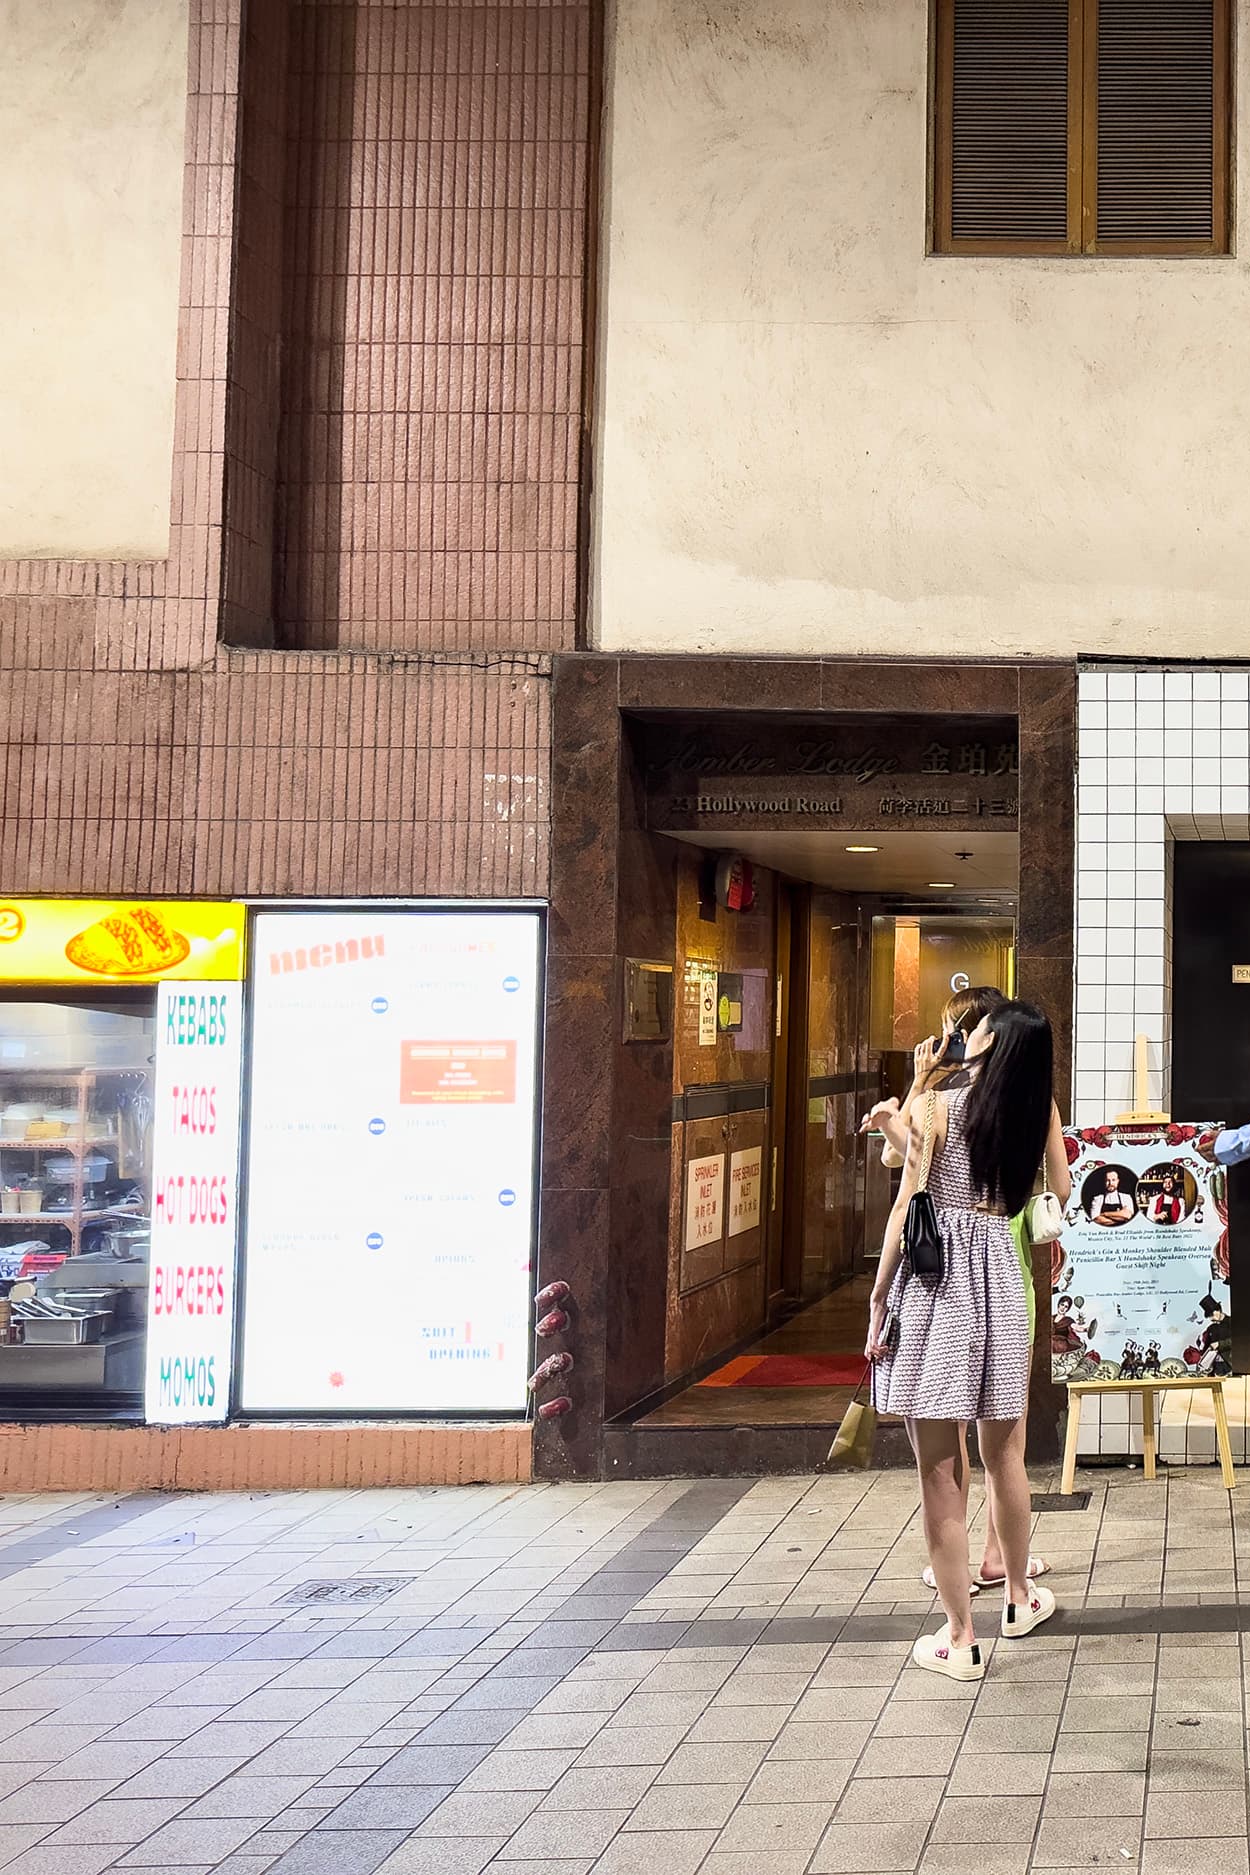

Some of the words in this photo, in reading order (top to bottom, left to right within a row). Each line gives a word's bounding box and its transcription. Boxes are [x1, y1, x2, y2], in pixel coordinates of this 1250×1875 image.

[788, 740, 899, 783] Lodge
[697, 796, 792, 815] Hollywood
[796, 797, 842, 813] Road
[269, 934, 384, 976] menu
[951, 972, 969, 993] G
[167, 995, 227, 1045] KEBABS
[172, 1086, 217, 1135] TACOS
[156, 1176, 184, 1224] HOT
[190, 1176, 227, 1224] DOGS
[155, 1266, 224, 1315] BURGERS
[159, 1355, 216, 1407] MOMOS
